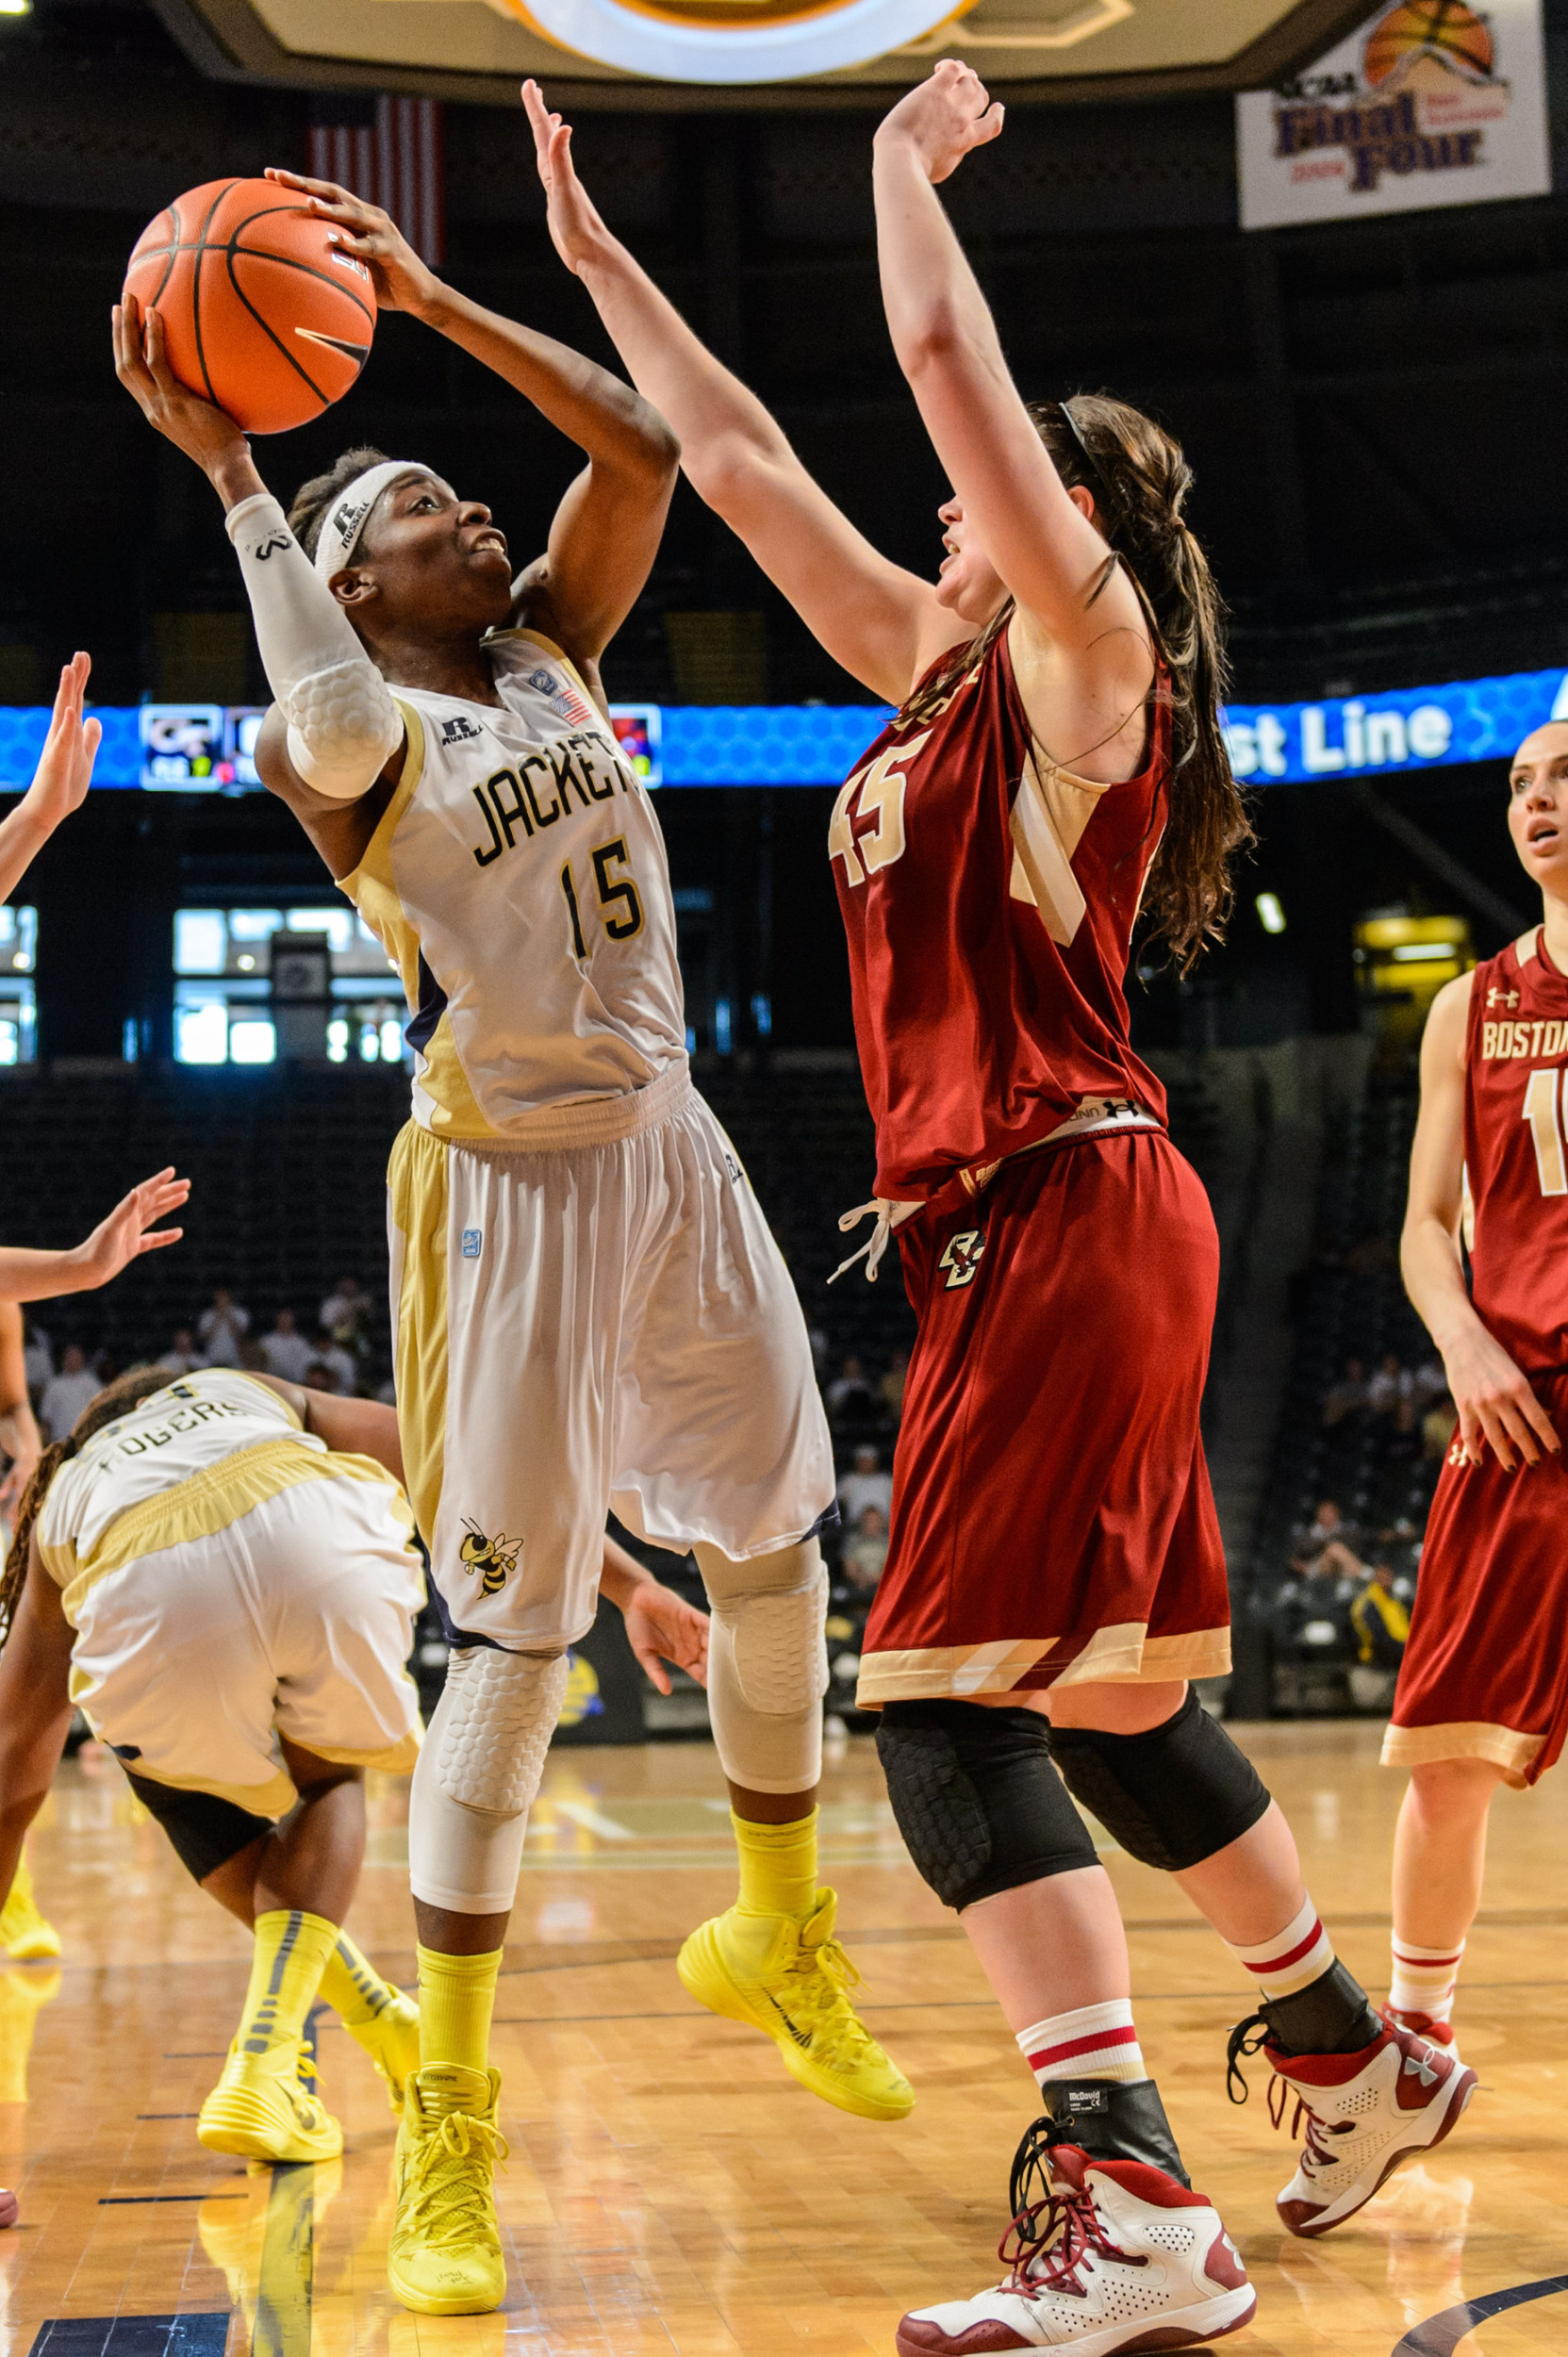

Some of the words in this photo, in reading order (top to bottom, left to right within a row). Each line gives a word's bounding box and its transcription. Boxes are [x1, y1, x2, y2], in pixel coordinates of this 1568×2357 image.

[472, 732, 643, 866] JACKET
[1300, 701, 1454, 774] Line
[828, 728, 933, 888] 45
[560, 834, 645, 961] 15
[1522, 1067, 1568, 1197] 1
